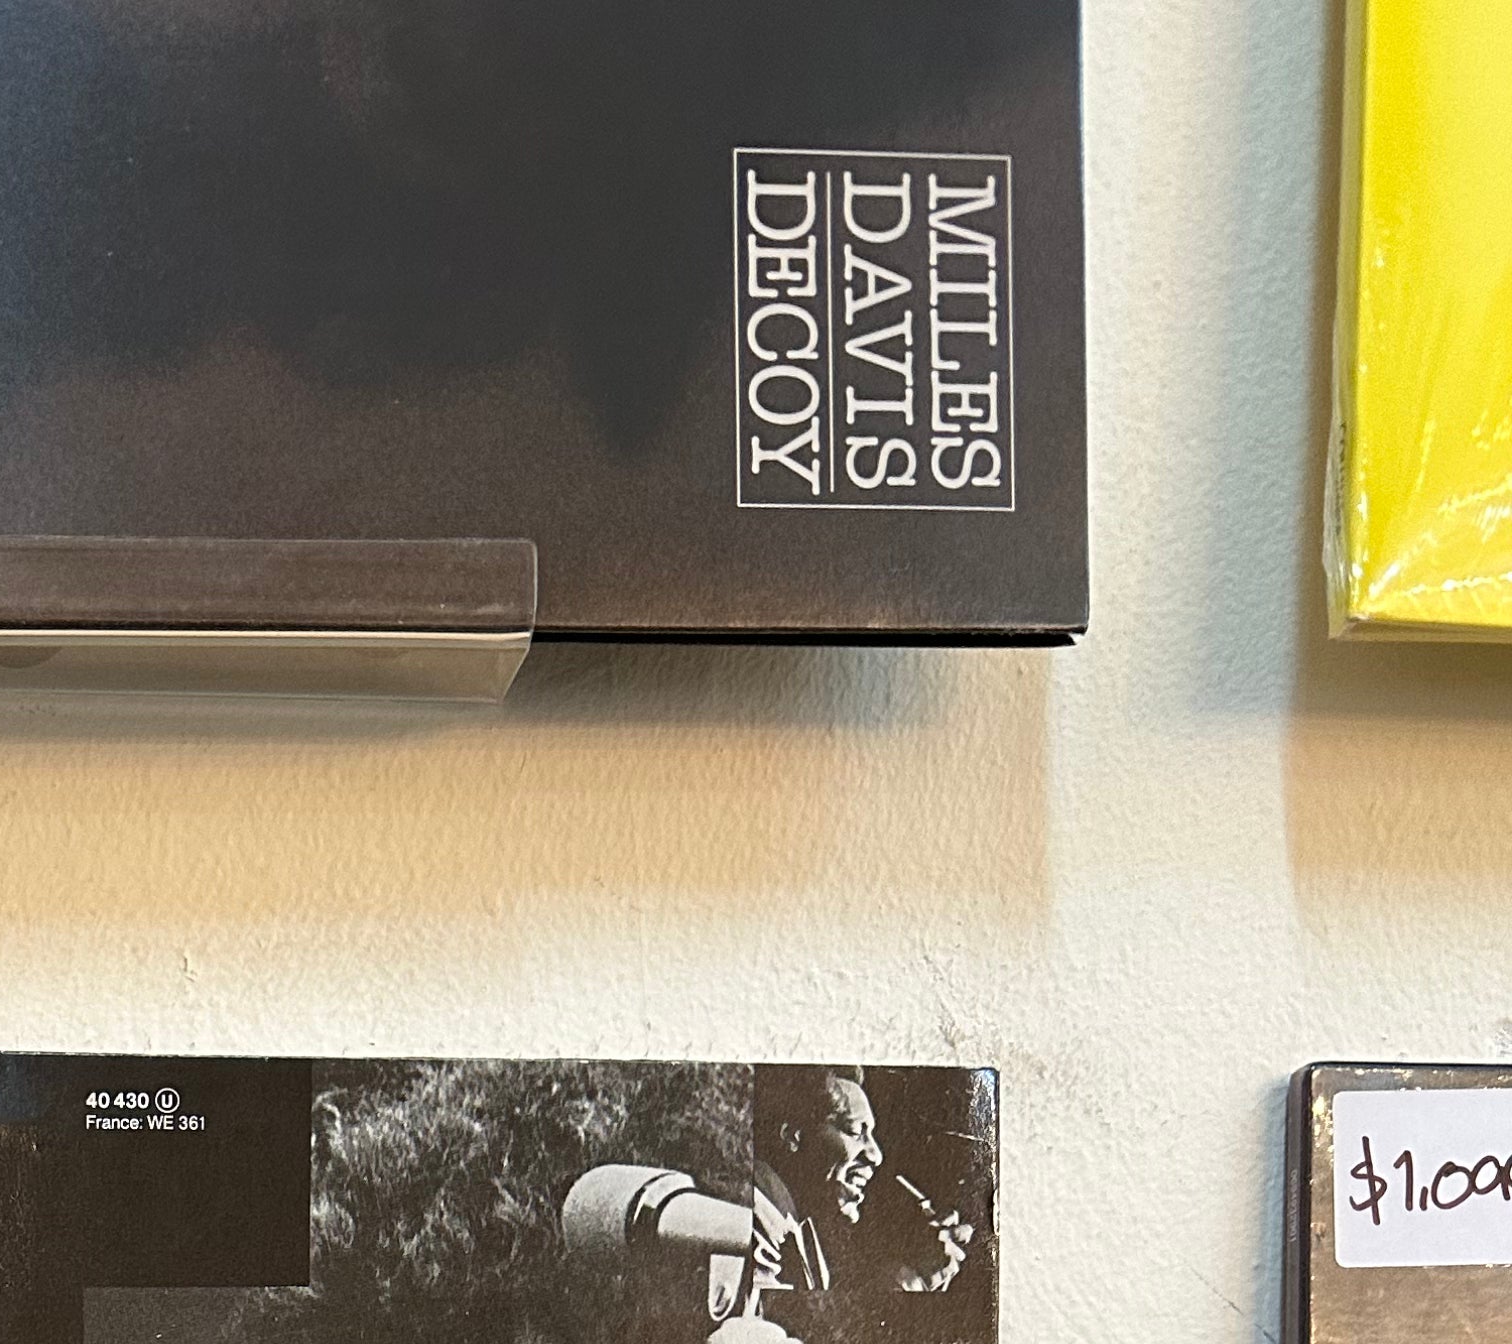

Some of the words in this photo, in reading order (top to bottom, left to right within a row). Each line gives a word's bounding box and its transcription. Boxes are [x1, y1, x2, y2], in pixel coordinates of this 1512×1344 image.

[747, 169, 820, 496] DECOY
[844, 171, 917, 490] DAVIS
[929, 173, 1001, 490] MILES
[85, 1092, 111, 1109] 40
[113, 1092, 150, 1109] 430
[85, 1114, 143, 1130] France:
[146, 1114, 175, 1130] WE
[178, 1115, 205, 1131] 361
